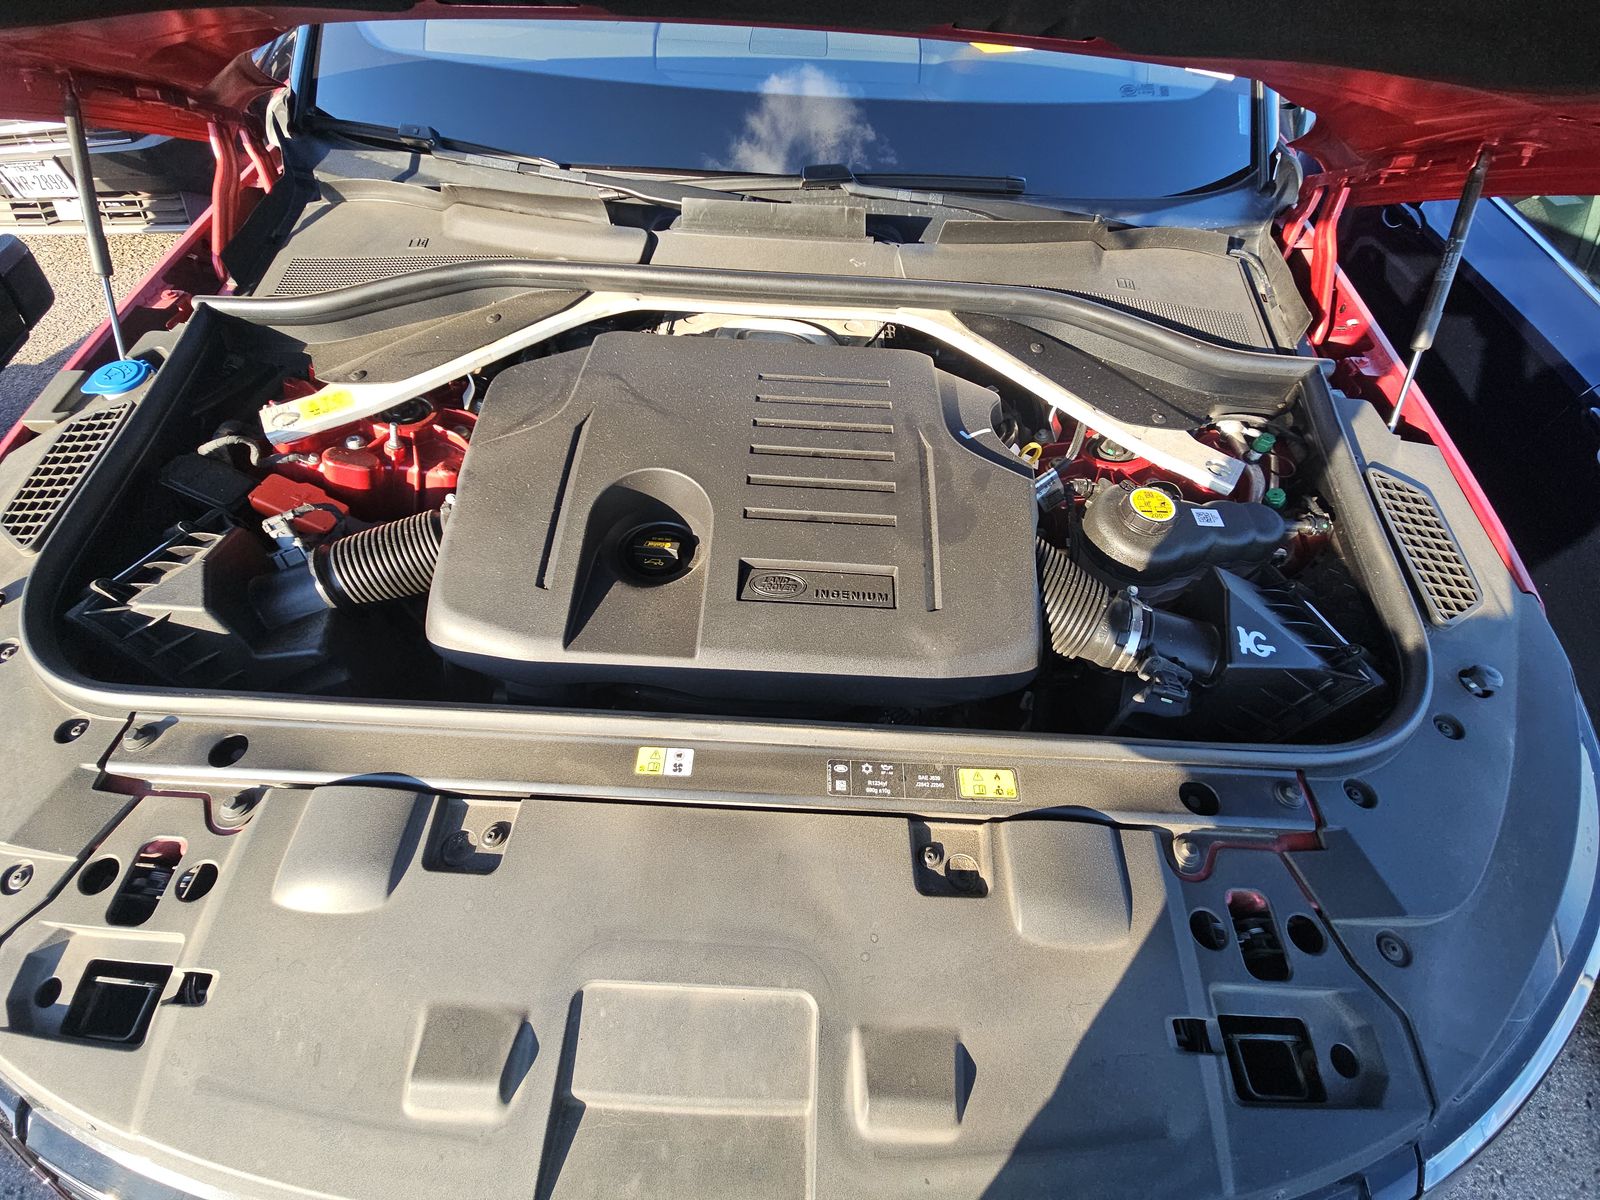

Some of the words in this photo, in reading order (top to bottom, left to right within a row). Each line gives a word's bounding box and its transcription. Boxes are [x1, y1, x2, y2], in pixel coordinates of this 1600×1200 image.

[761, 576, 792, 584] LAND
[761, 583, 798, 592] ROVER
[814, 588, 889, 603] INGENIUM
